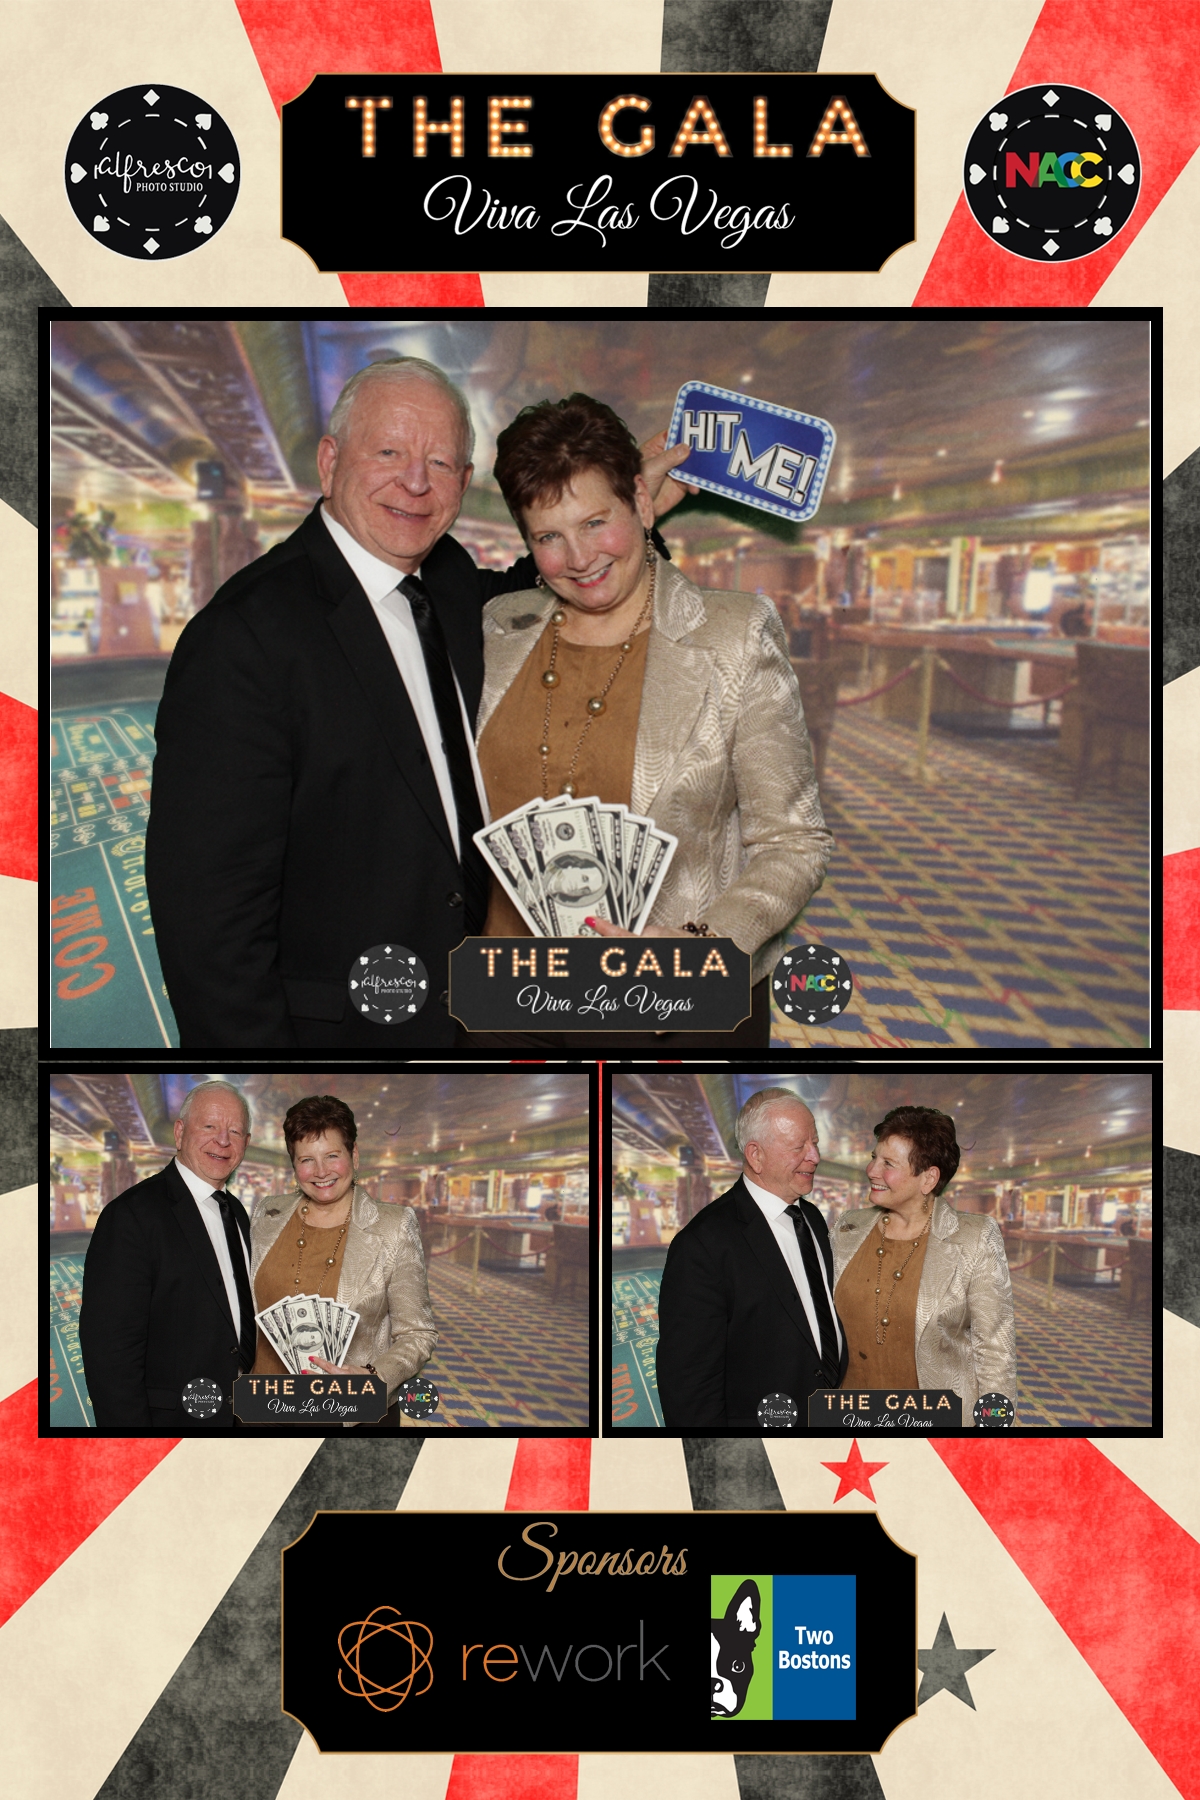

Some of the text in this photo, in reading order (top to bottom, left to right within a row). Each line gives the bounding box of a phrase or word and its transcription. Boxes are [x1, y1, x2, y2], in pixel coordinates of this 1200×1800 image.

[682, 411, 742, 453] HIT
[727, 428, 818, 506] ME!
[51, 885, 117, 1000] COME
